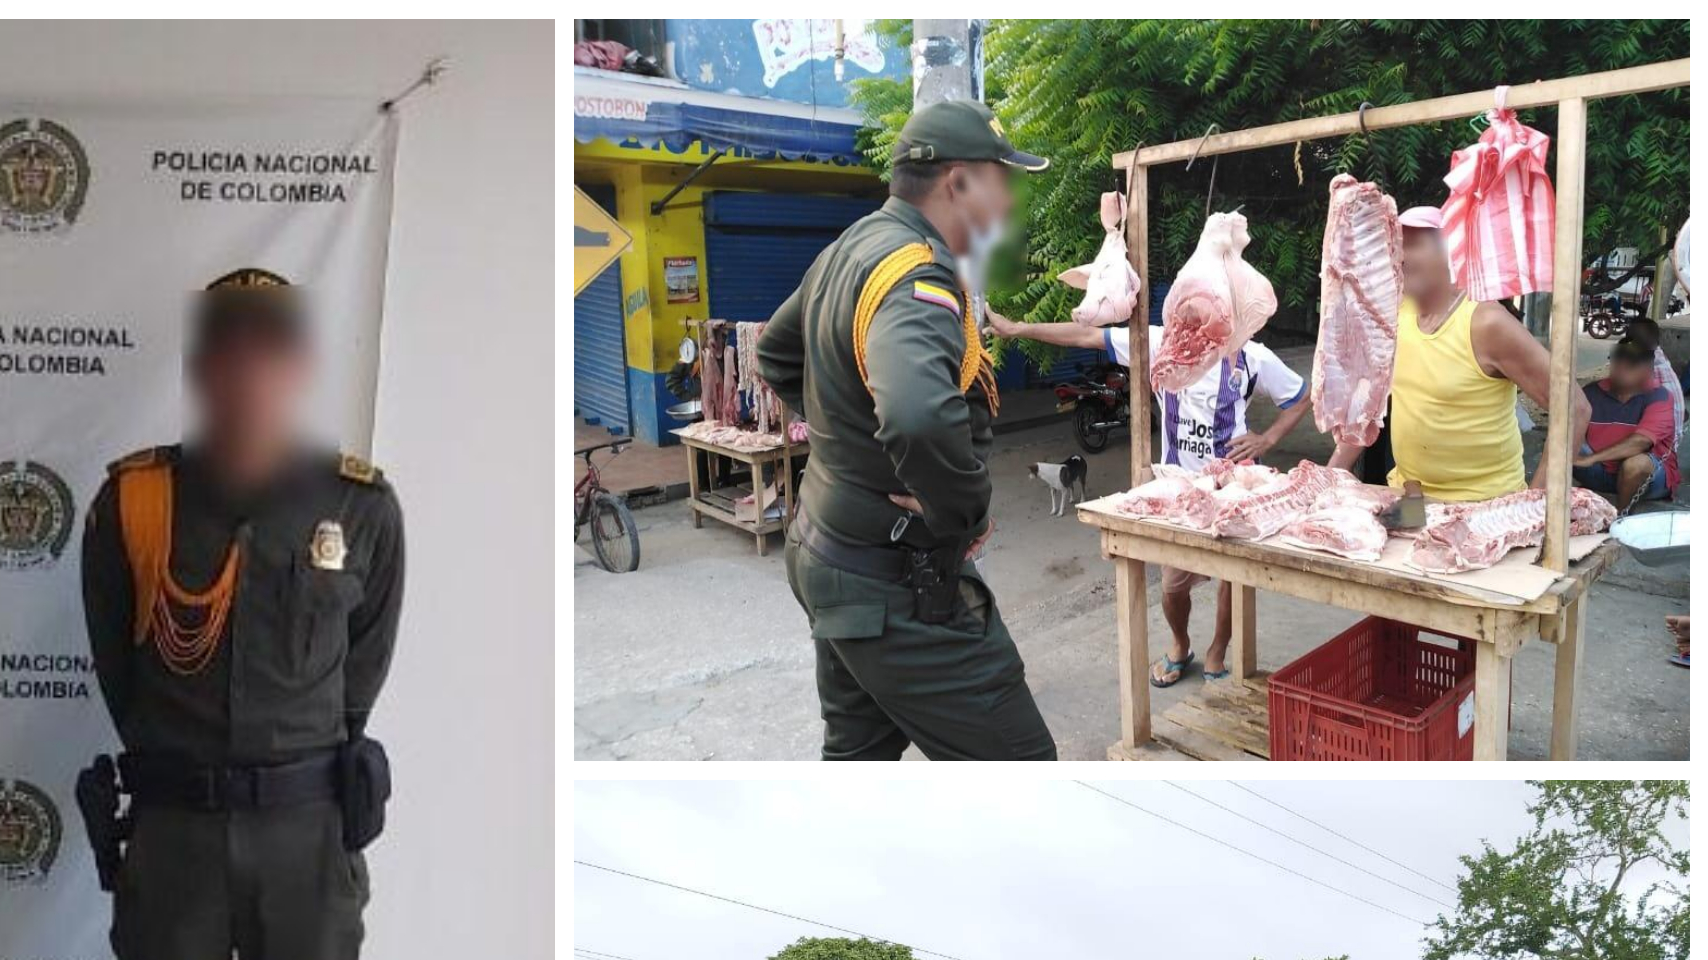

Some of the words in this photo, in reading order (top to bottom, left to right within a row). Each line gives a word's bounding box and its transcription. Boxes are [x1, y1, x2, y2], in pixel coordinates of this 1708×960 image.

[574, 96, 646, 117] OSTOBON
[153, 152, 247, 172] POLICIA
[255, 155, 376, 174] NACIONAL
[181, 182, 212, 200] DE
[221, 183, 346, 202] COLOMBIA
[13, 325, 134, 347] NACIONAL
[1, 654, 95, 673] NACION
